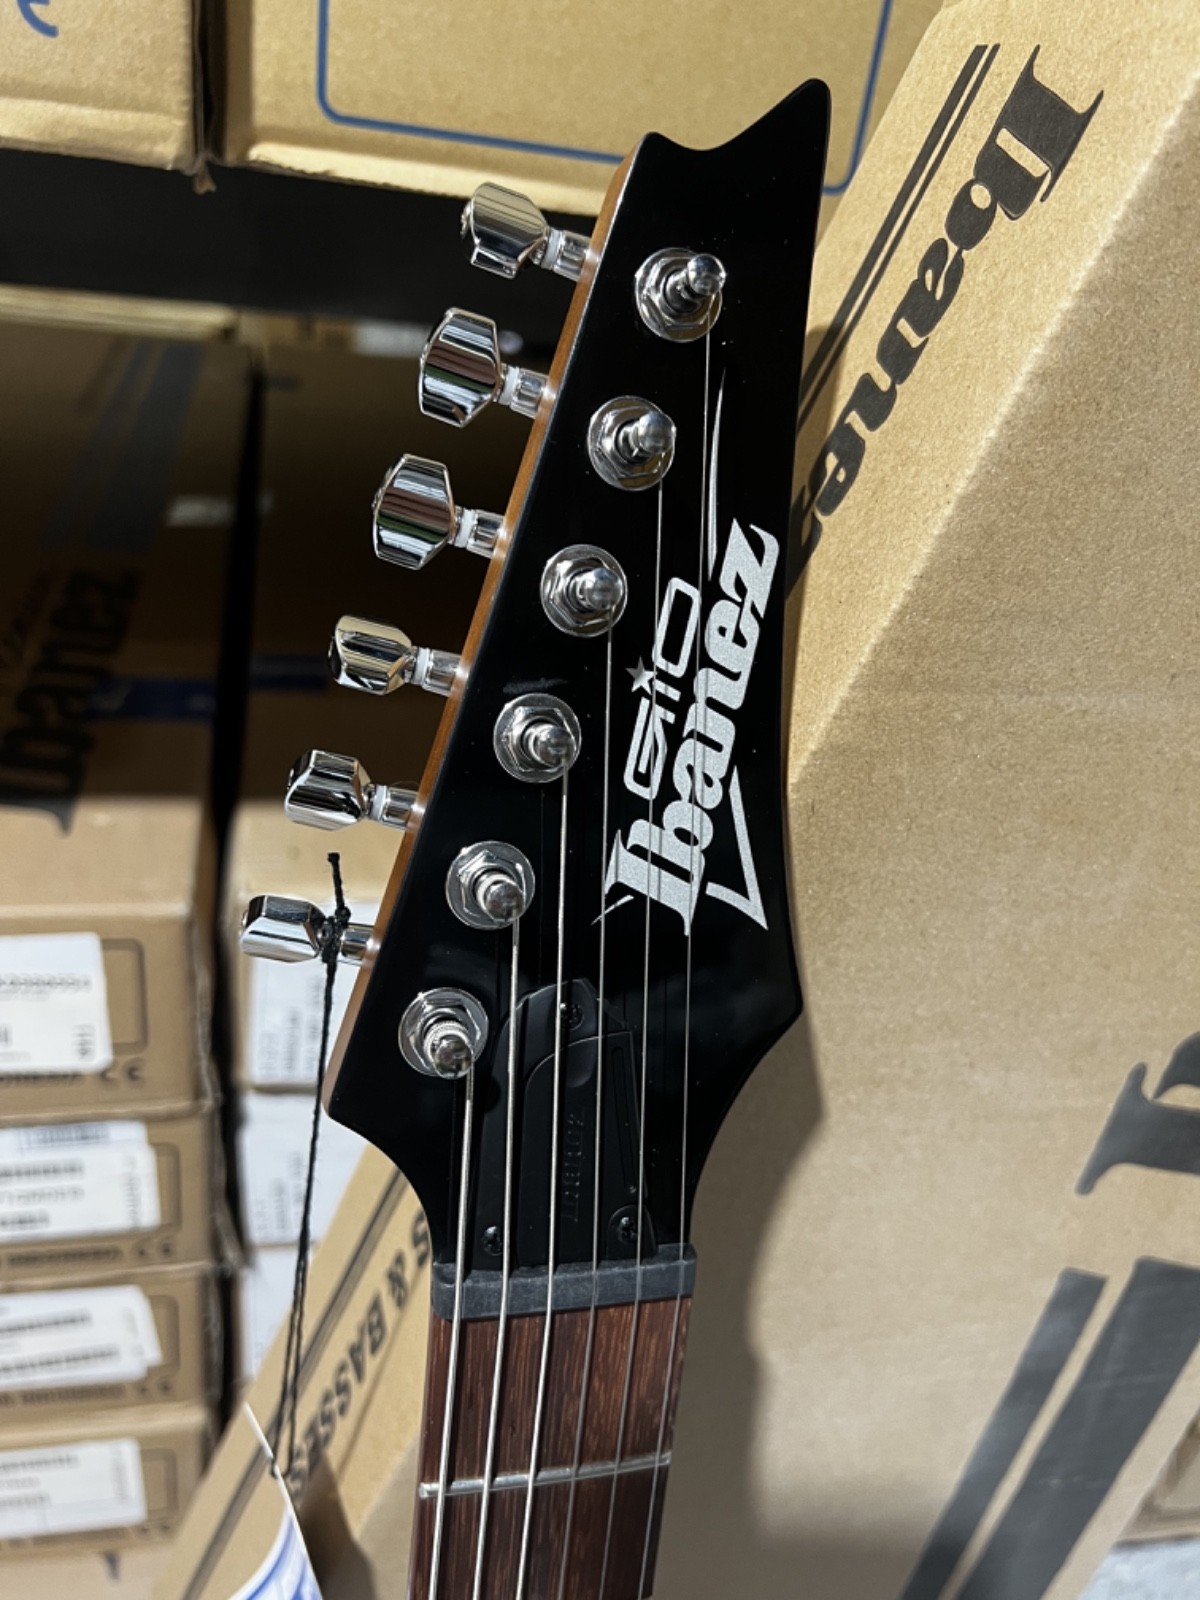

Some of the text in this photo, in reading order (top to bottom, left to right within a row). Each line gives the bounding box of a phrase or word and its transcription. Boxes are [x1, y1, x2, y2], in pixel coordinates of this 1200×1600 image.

[604, 518, 780, 936] Ibanez
[387, 1246, 411, 1309] &
[284, 1288, 387, 1506] BASSES
